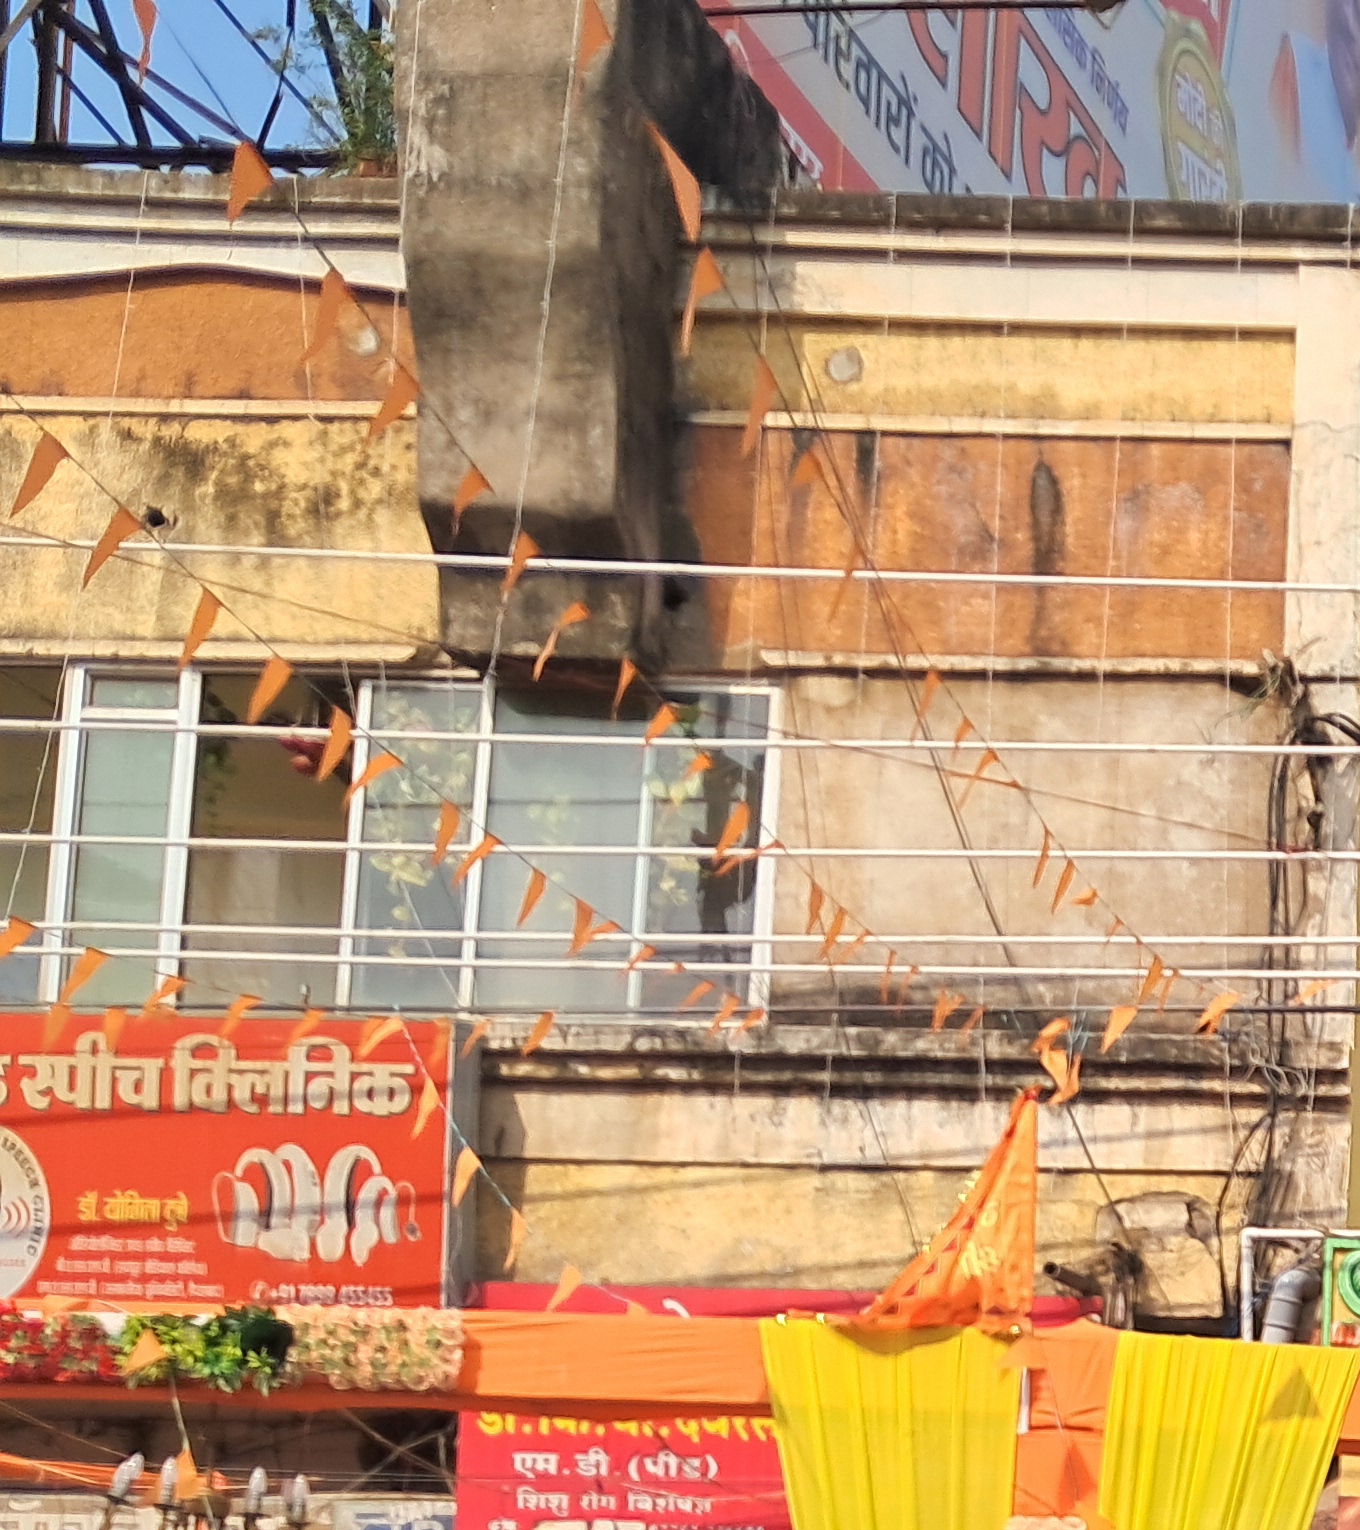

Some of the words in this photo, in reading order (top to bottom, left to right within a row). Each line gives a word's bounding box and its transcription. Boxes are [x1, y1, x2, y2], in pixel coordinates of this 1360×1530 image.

[18, 1031, 165, 1112] स्पीच
[172, 1034, 416, 1116] क्लिनिक
[517, 1486, 570, 1517] शिशु
[580, 1491, 617, 1511] रोग
